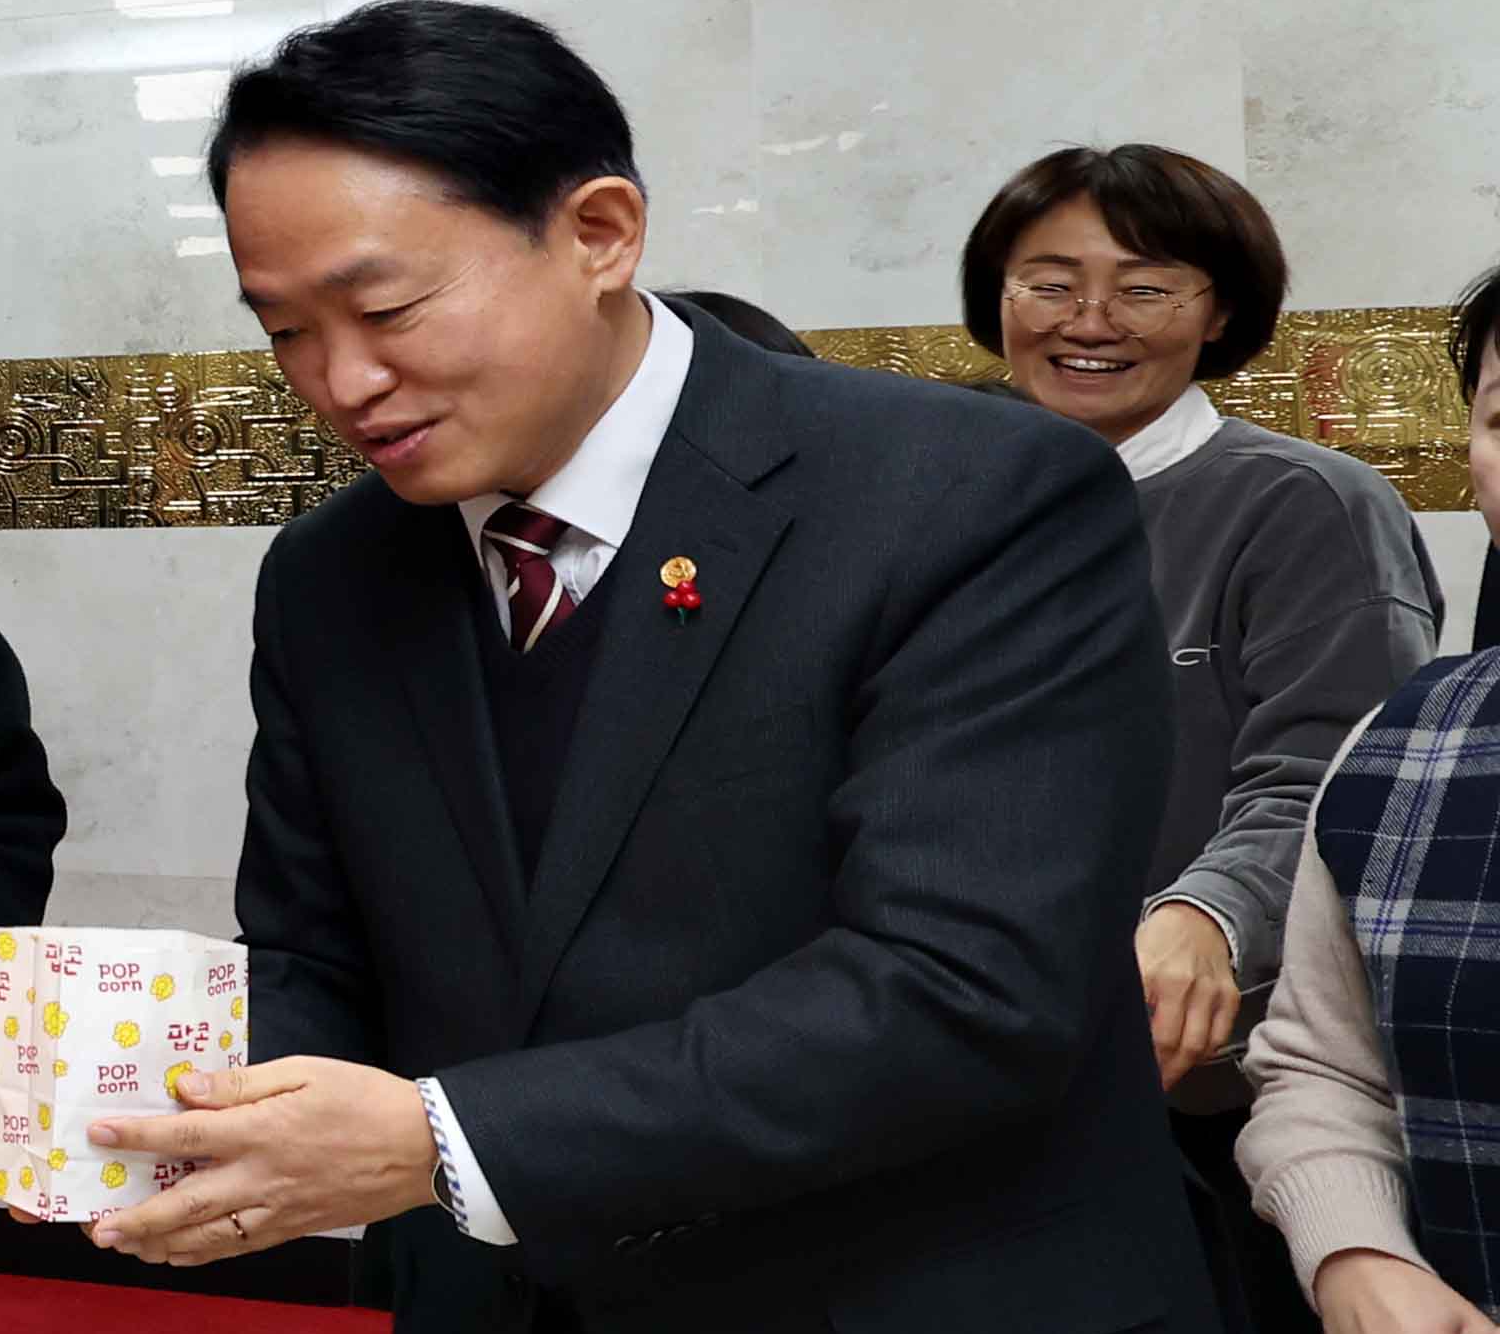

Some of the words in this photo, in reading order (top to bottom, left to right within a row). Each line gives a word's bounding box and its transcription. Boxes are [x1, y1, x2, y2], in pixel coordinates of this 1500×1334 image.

[99, 963, 140, 979] POP
[98, 979, 143, 994] corn
[167, 1021, 210, 1053] 팝콘
[98, 1064, 138, 1080] POP
[97, 1079, 139, 1094] corn
